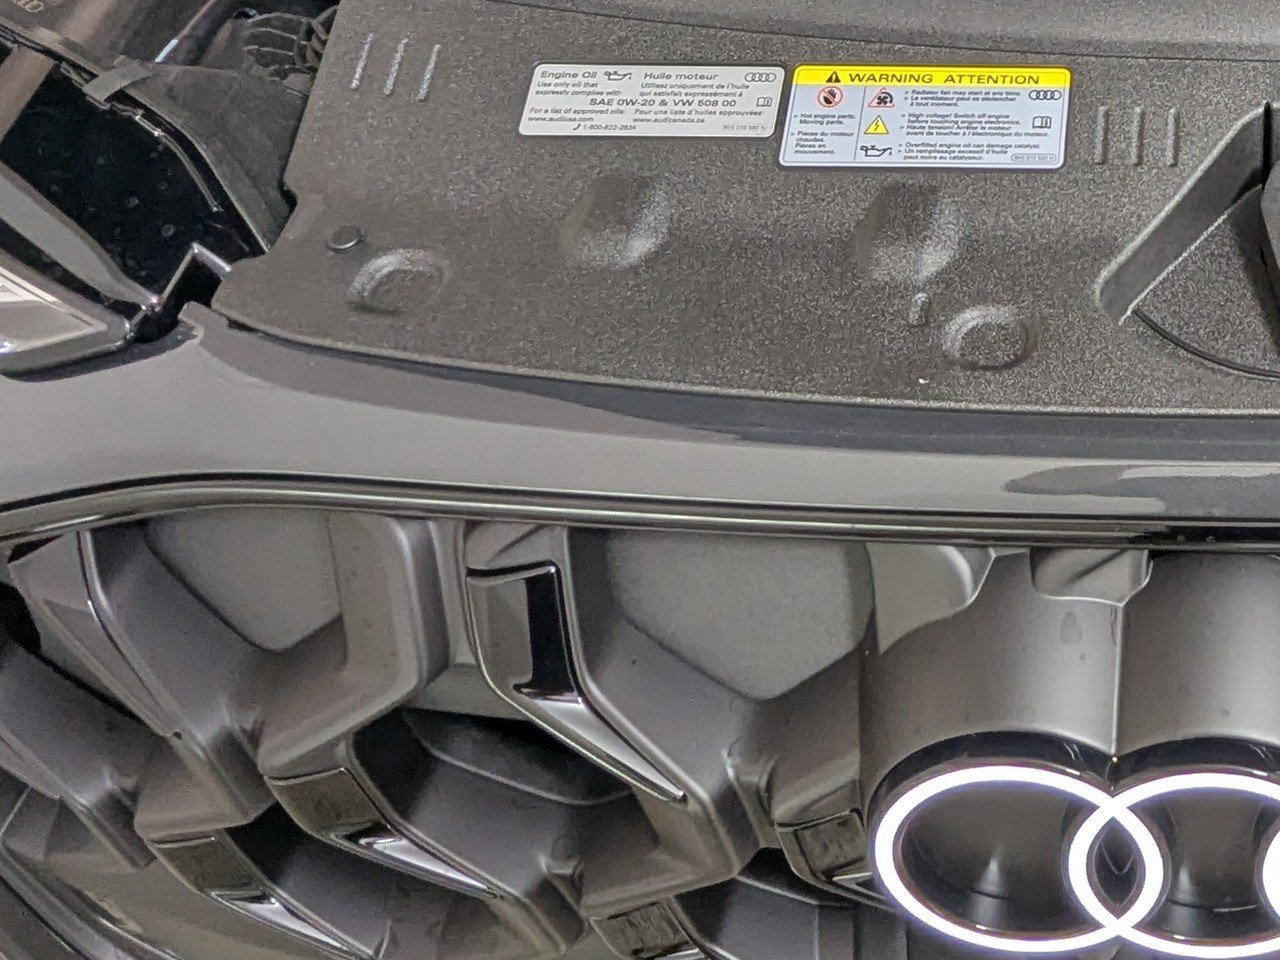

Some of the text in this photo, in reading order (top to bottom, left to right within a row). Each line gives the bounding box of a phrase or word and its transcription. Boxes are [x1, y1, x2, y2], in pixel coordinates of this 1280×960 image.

[541, 71, 579, 80] Engine
[644, 72, 672, 80] Huile
[849, 74, 1040, 84] WARNING ATTENTION
[617, 99, 656, 107] 0W-20
[659, 99, 668, 107] &
[673, 99, 695, 107] VW
